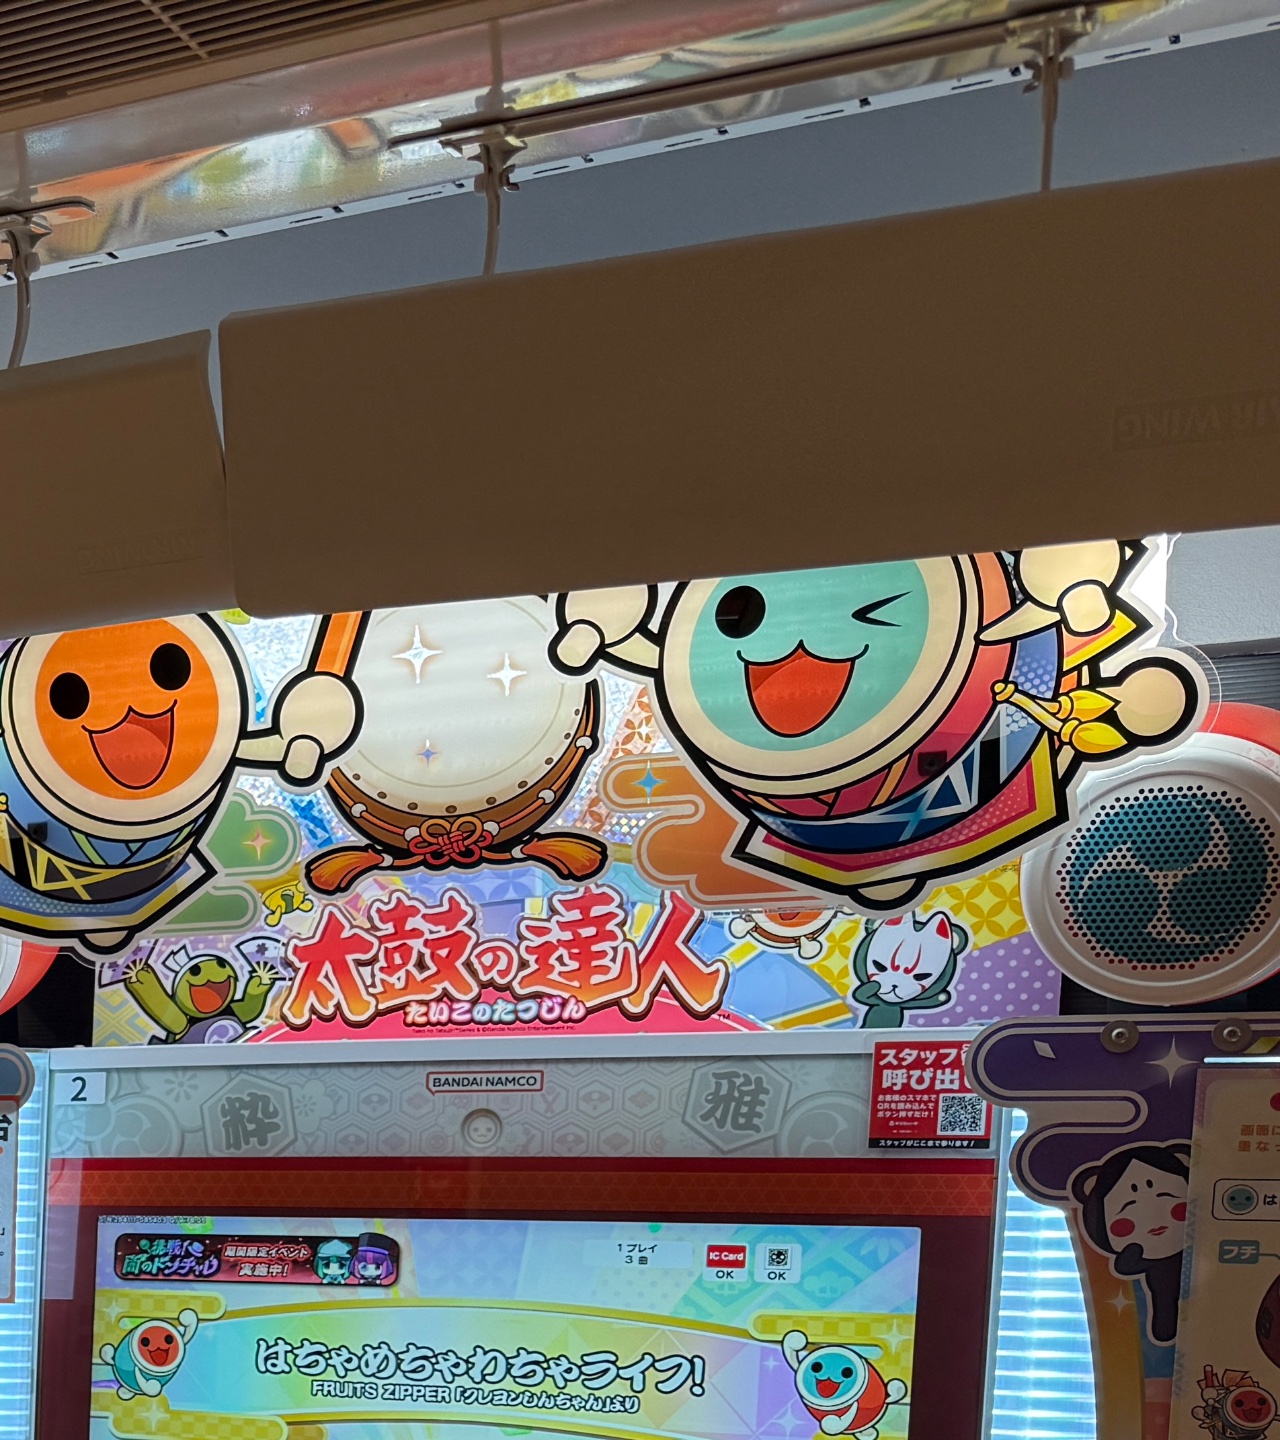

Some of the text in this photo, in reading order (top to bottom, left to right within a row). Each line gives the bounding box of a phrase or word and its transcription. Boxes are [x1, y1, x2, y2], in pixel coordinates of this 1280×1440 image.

[281, 884, 729, 1030] 太鼓の達人
[404, 997, 587, 1026] たいこのたつじん
[879, 1048, 958, 1066] スタッフ
[70, 1076, 88, 1102] 2
[433, 1076, 537, 1088] BANDAI NAMCO
[1263, 1194, 1277, 1205] は
[709, 1251, 744, 1262] IC Card
[1223, 1246, 1257, 1259] フチ
[239, 1261, 289, 1277] 実施中!
[716, 1269, 786, 1281] OK OK
[255, 1336, 705, 1397] はちゃめちゃわちゃライフ!
[311, 1380, 640, 1414] FRUITS ZIPPER 「クレヨンしんちゃん」より
